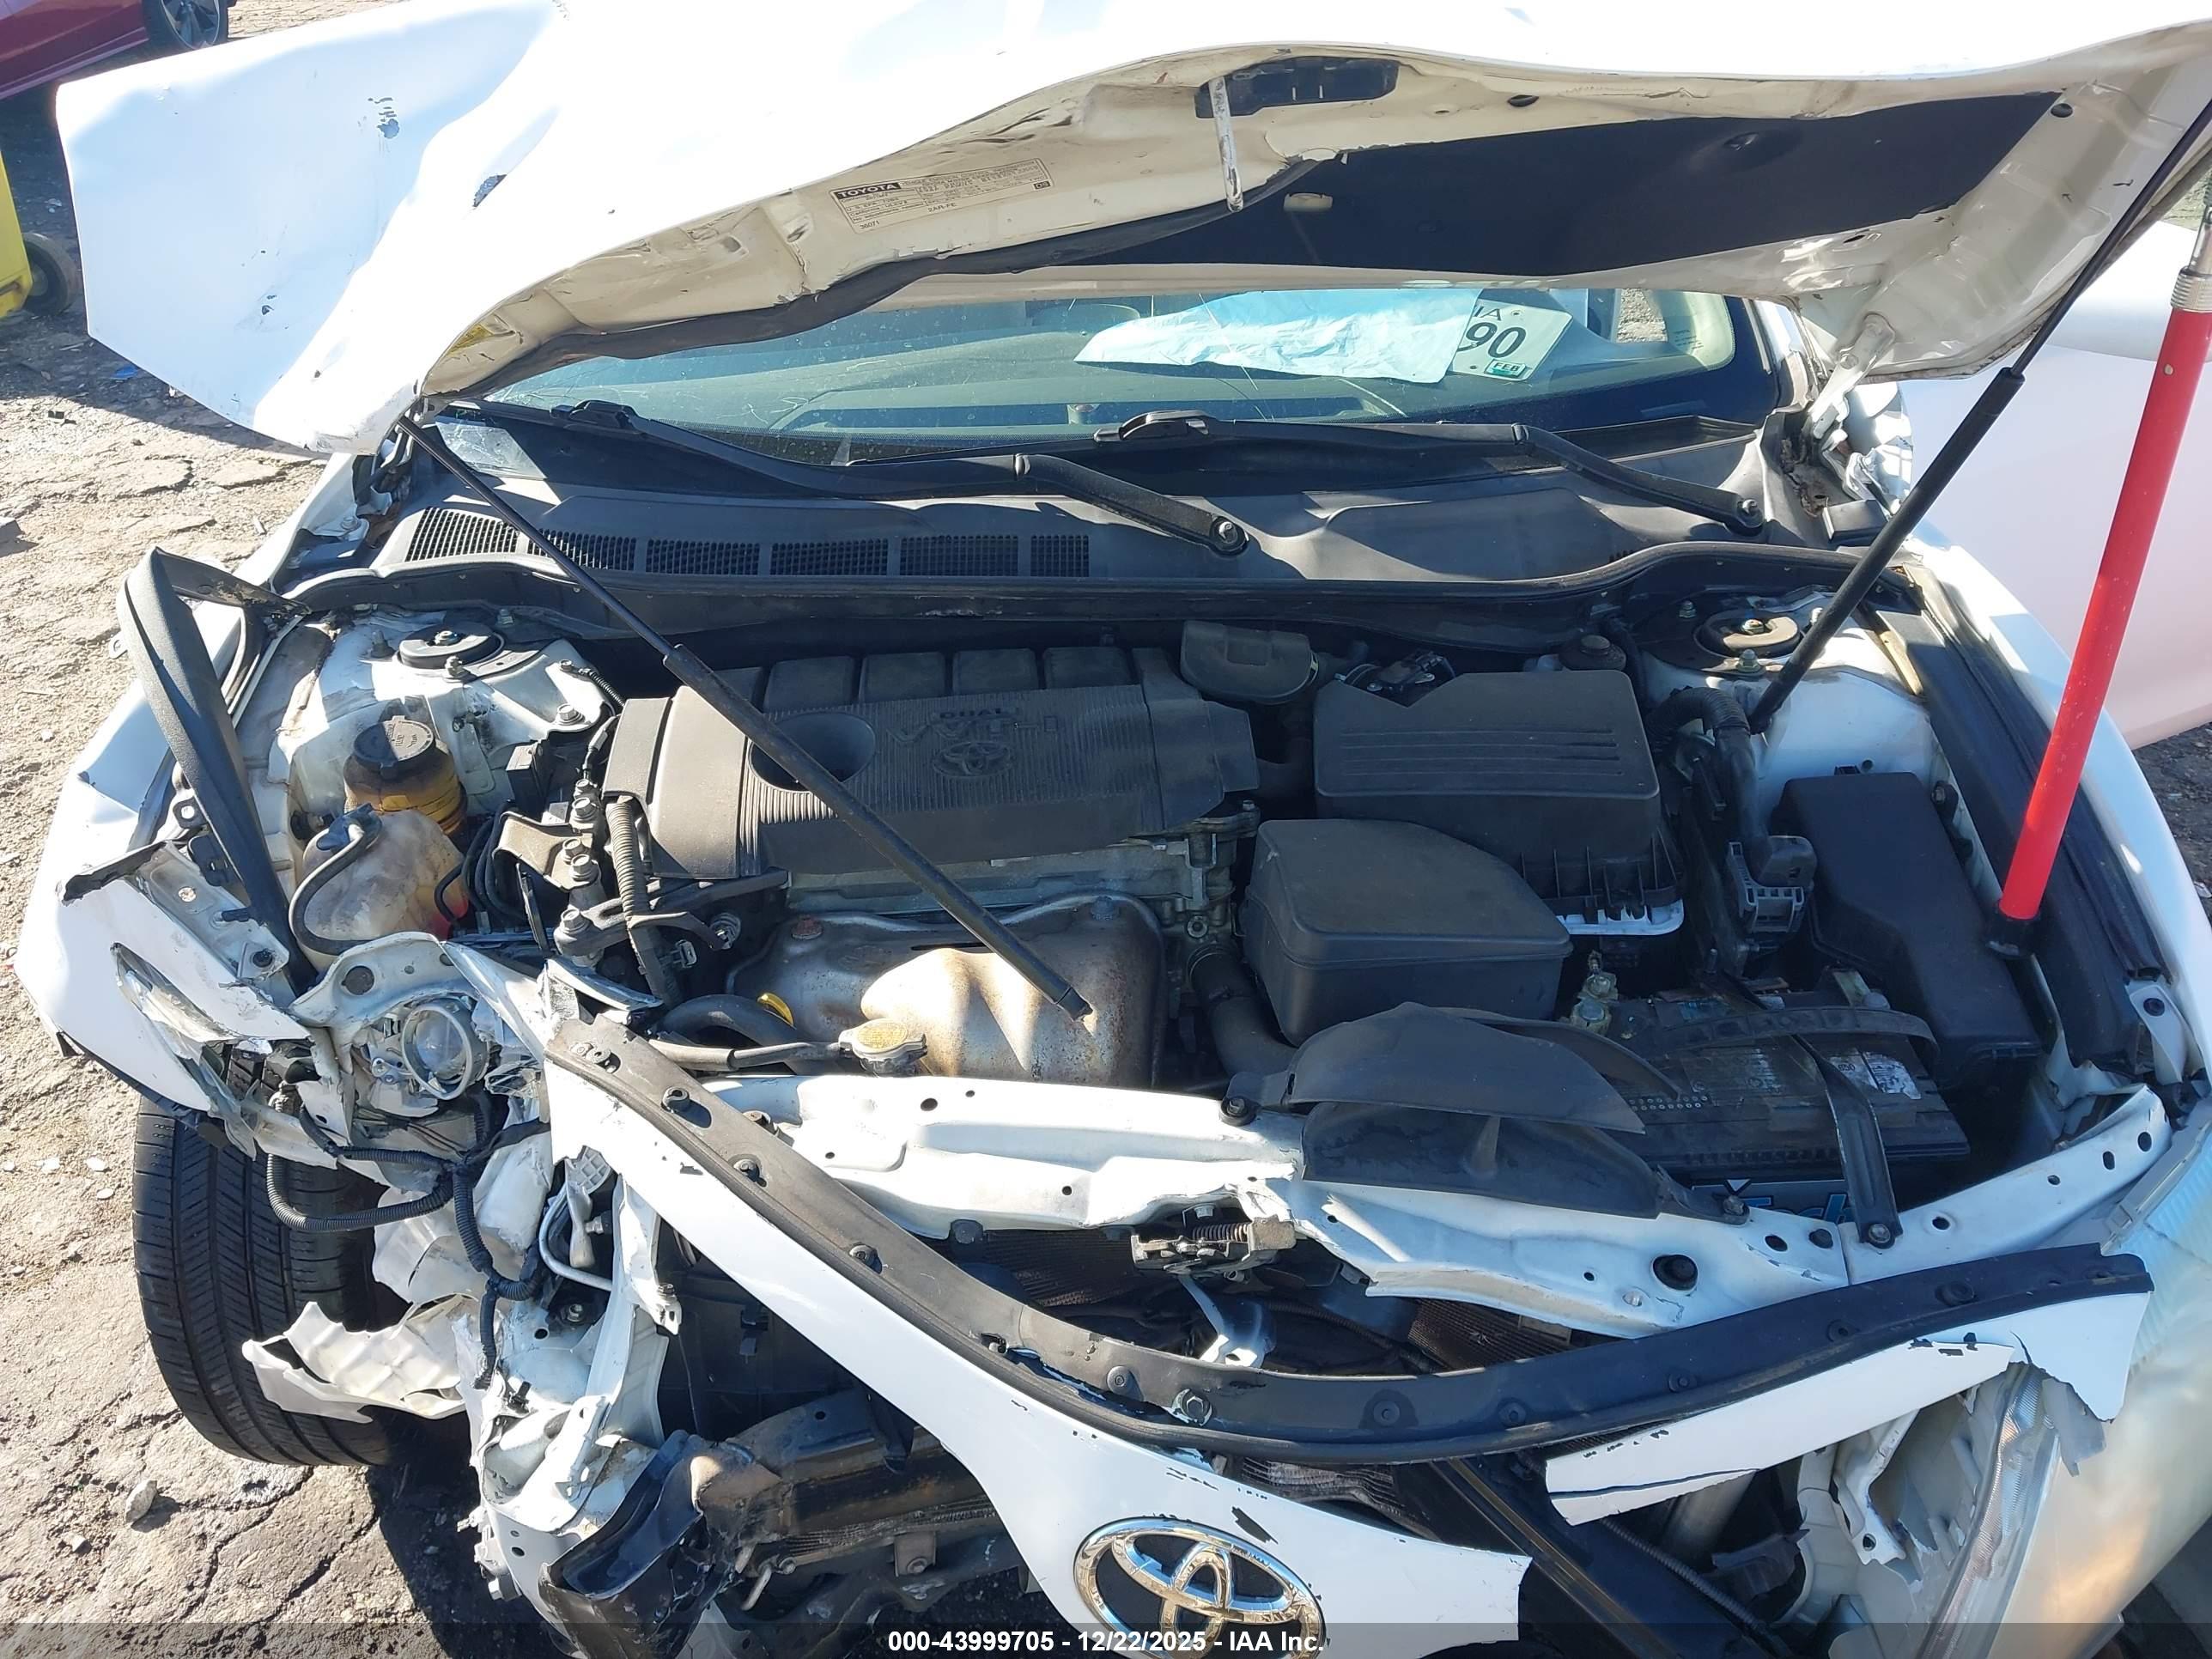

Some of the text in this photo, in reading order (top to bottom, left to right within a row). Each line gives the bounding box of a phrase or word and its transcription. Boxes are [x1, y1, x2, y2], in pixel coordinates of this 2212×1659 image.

[838, 184, 896, 198] TOYOTA
[927, 202, 957, 212] 2AR-FE
[1456, 322, 1527, 358] 90
[1493, 362, 1521, 372] FEB
